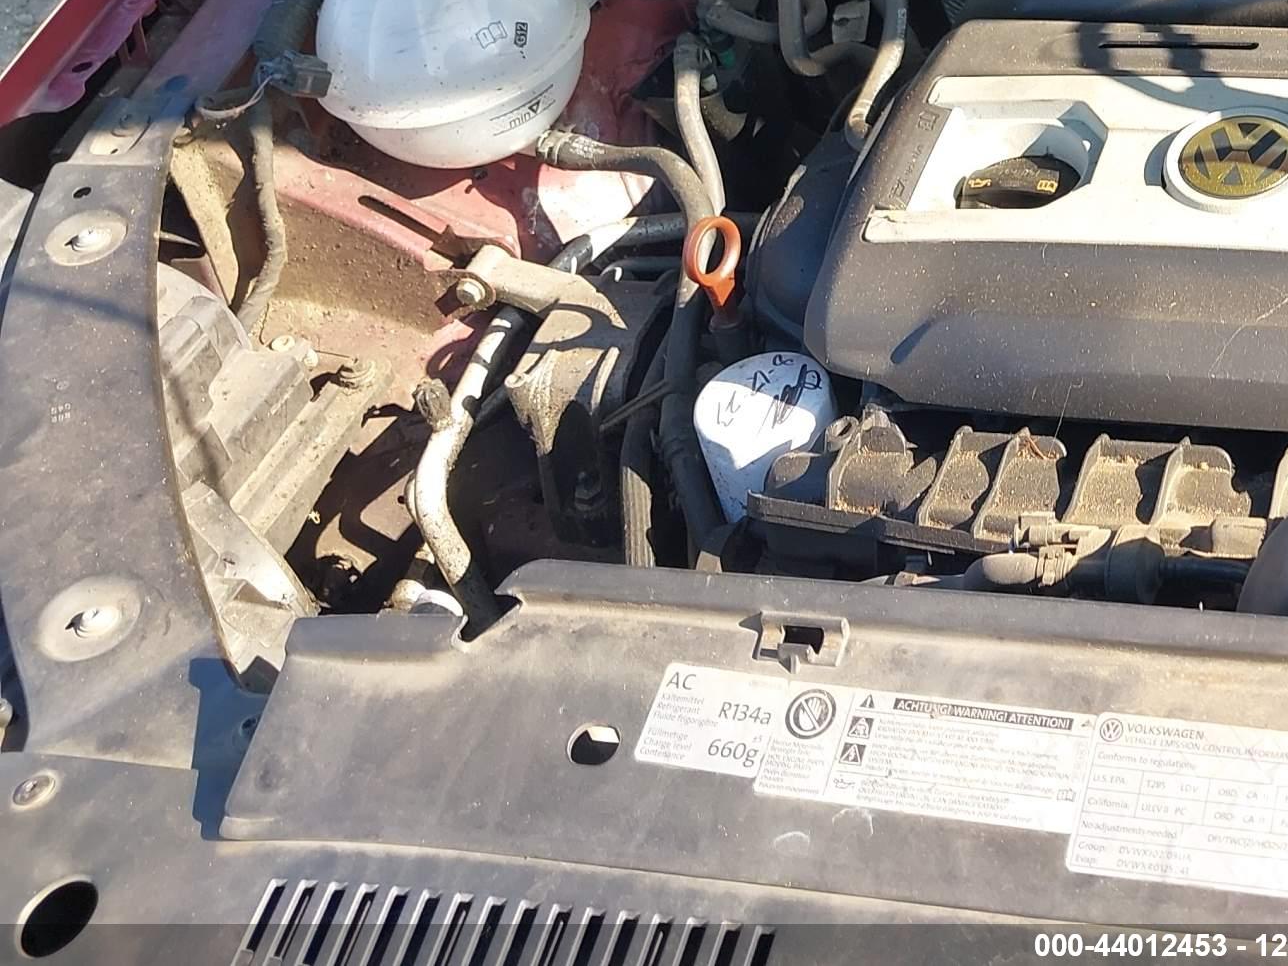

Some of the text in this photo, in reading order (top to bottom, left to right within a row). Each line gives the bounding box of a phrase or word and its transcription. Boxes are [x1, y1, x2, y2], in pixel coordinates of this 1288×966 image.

[516, 23, 528, 46] G12
[509, 111, 532, 130] min
[667, 671, 697, 691] AC
[657, 701, 700, 714] Refrigerant
[718, 701, 772, 725] R134a
[953, 706, 1008, 722] WARNING!
[1009, 714, 1070, 730] ATTENTION!
[1126, 721, 1205, 740] VOLKSWAGEN
[644, 736, 693, 752] Charge level
[707, 738, 759, 768] 660g
[1124, 735, 1157, 747] VEHICLE
[1159, 738, 1201, 751] EMISSION
[1202, 743, 1243, 756] CONTROL
[1097, 750, 1137, 764] Conforms
[1094, 821, 1145, 836] adjustments
